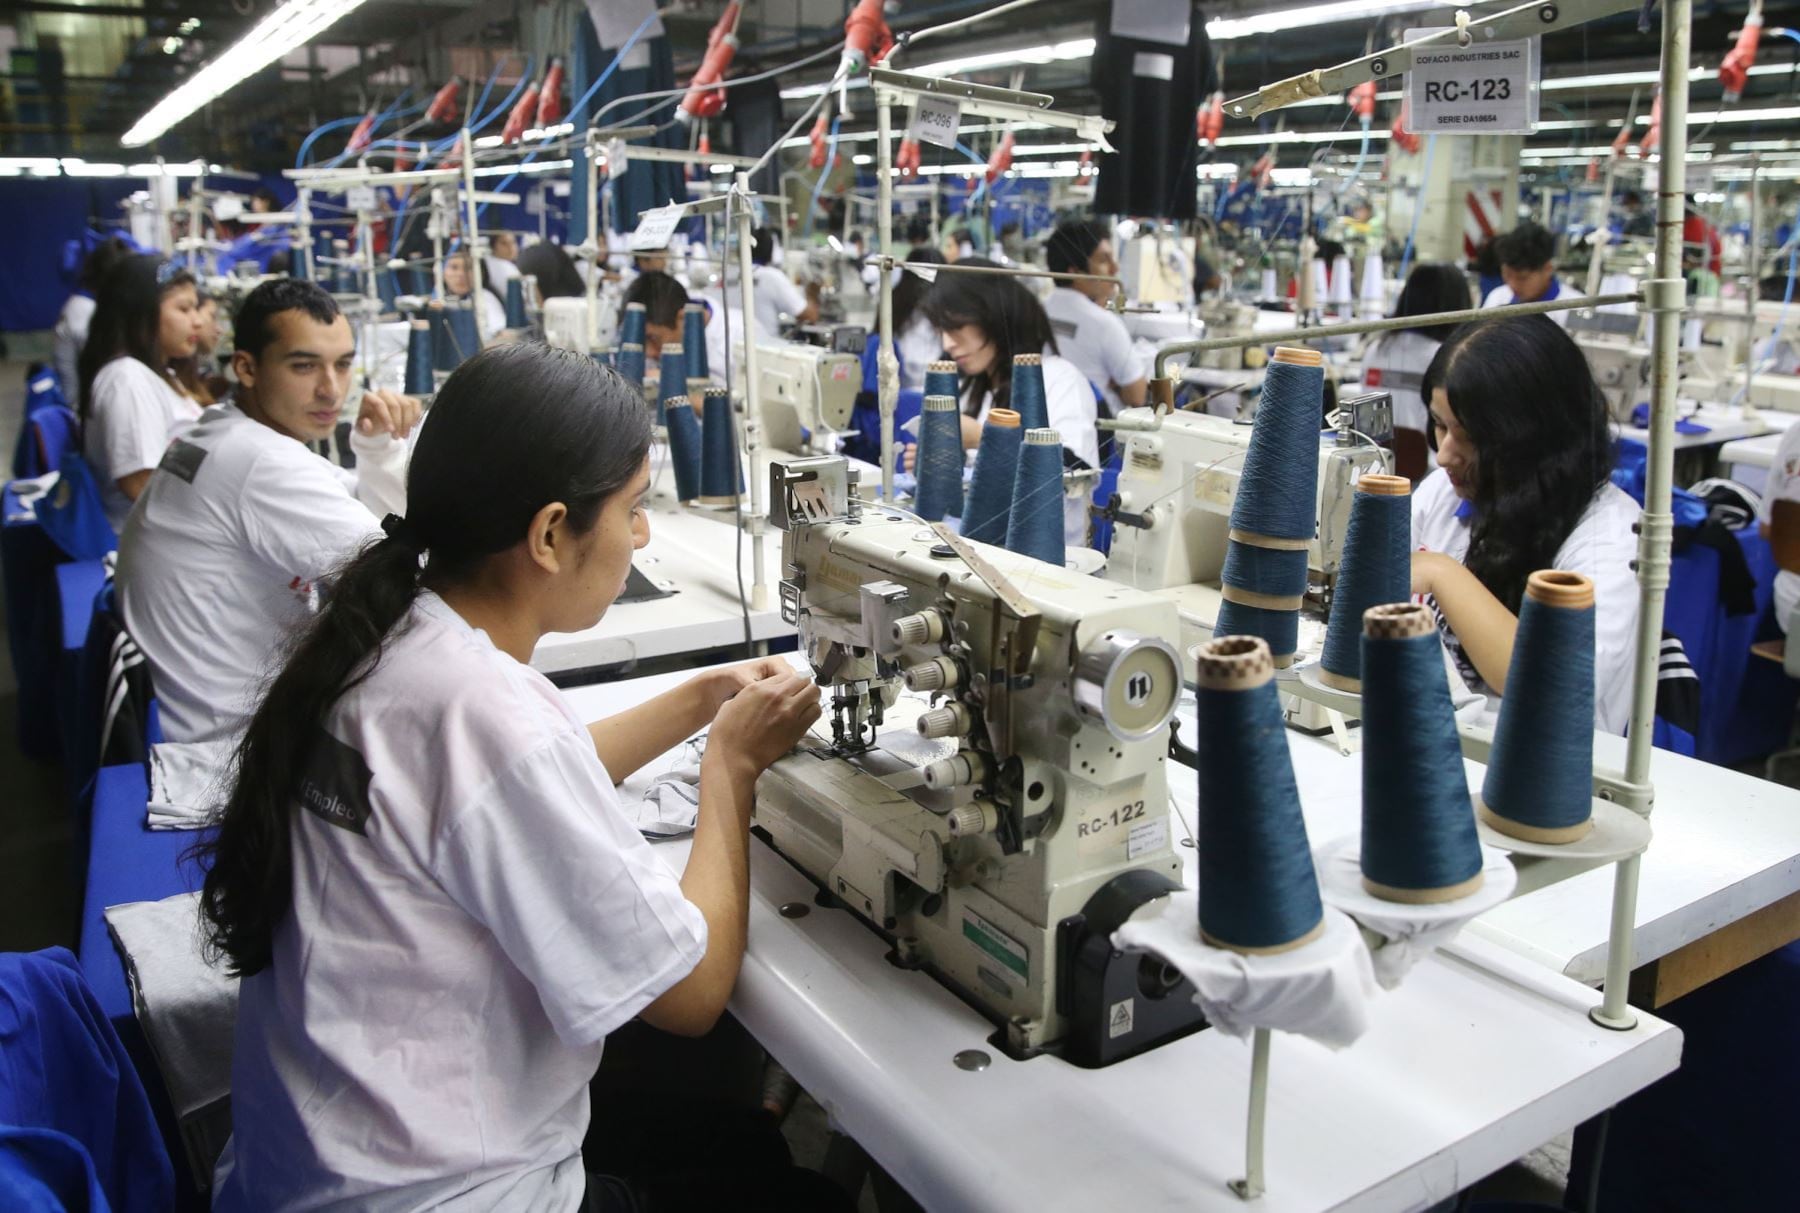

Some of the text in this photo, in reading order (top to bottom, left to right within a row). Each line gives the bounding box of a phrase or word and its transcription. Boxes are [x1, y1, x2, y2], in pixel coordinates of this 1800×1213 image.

[1416, 50, 1520, 65] COFACO INDUSTRIES SAC
[1425, 78, 1511, 102] RC-123
[920, 110, 952, 128] RC-096
[1437, 115, 1461, 124] SERIE
[304, 781, 357, 821] Empleo
[1078, 800, 1146, 838] RC-122
